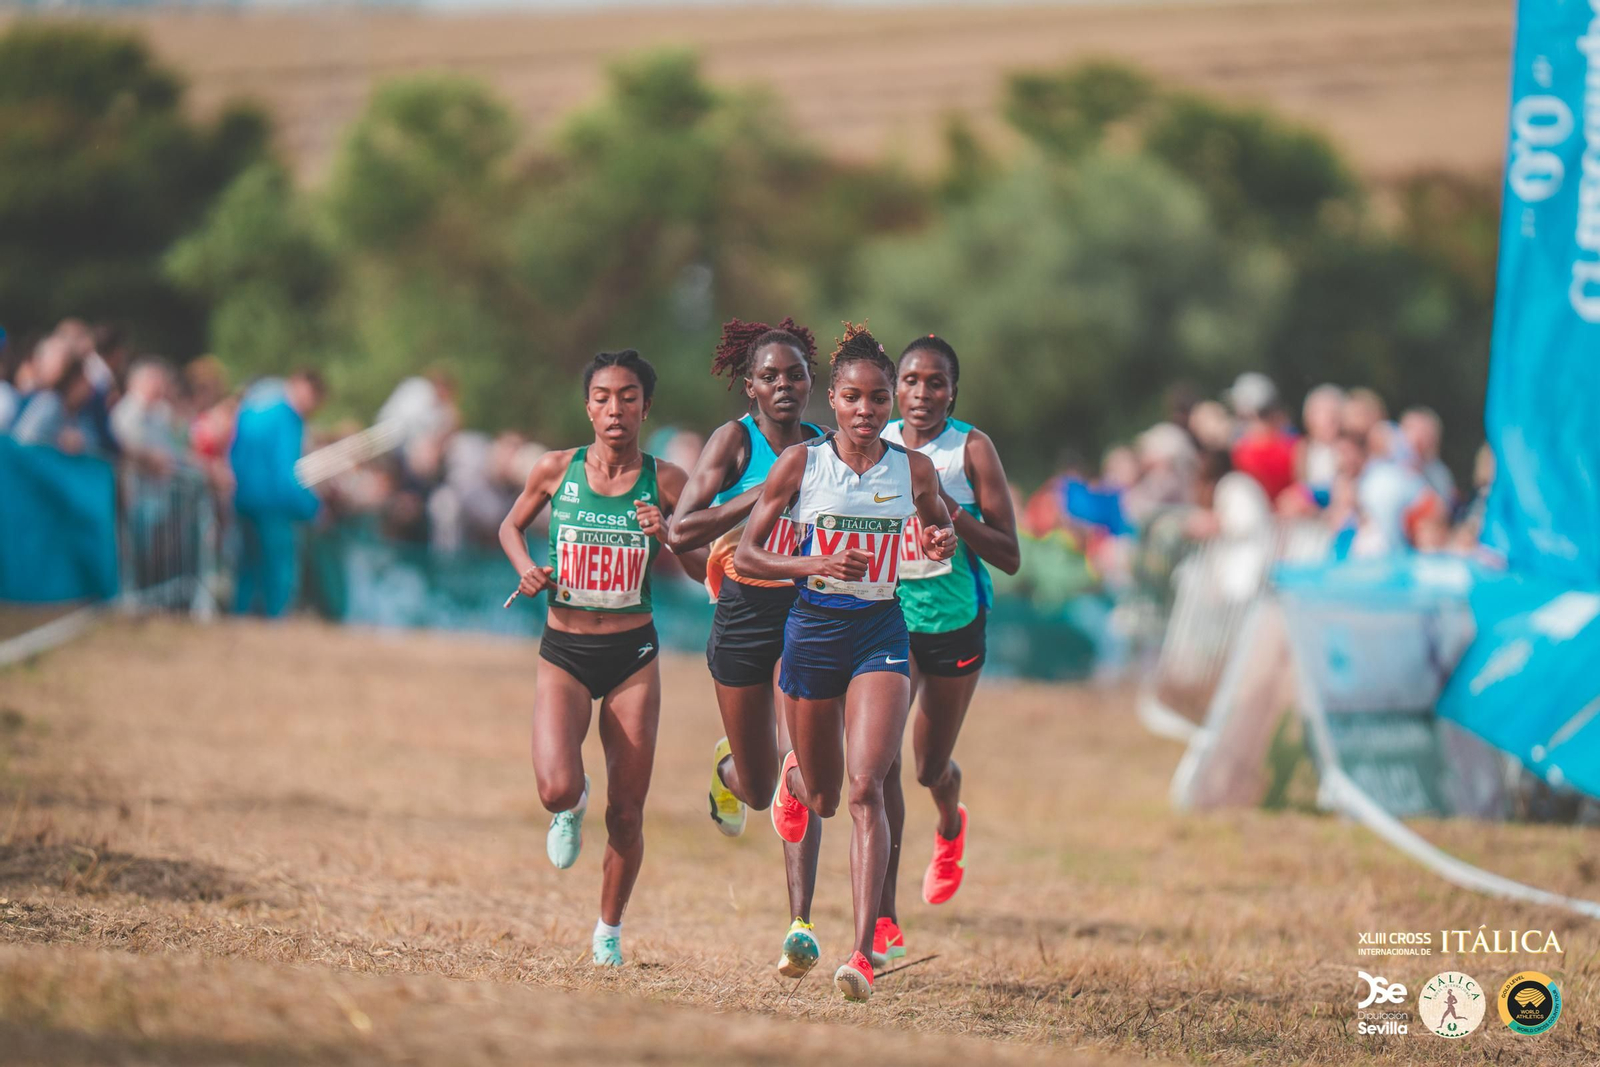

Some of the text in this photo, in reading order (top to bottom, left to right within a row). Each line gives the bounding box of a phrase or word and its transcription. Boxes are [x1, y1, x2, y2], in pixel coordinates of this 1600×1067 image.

[842, 518, 882, 530] ITÁLICA
[582, 532, 624, 544] ITÁLICA
[559, 543, 645, 592] AMEBAW
